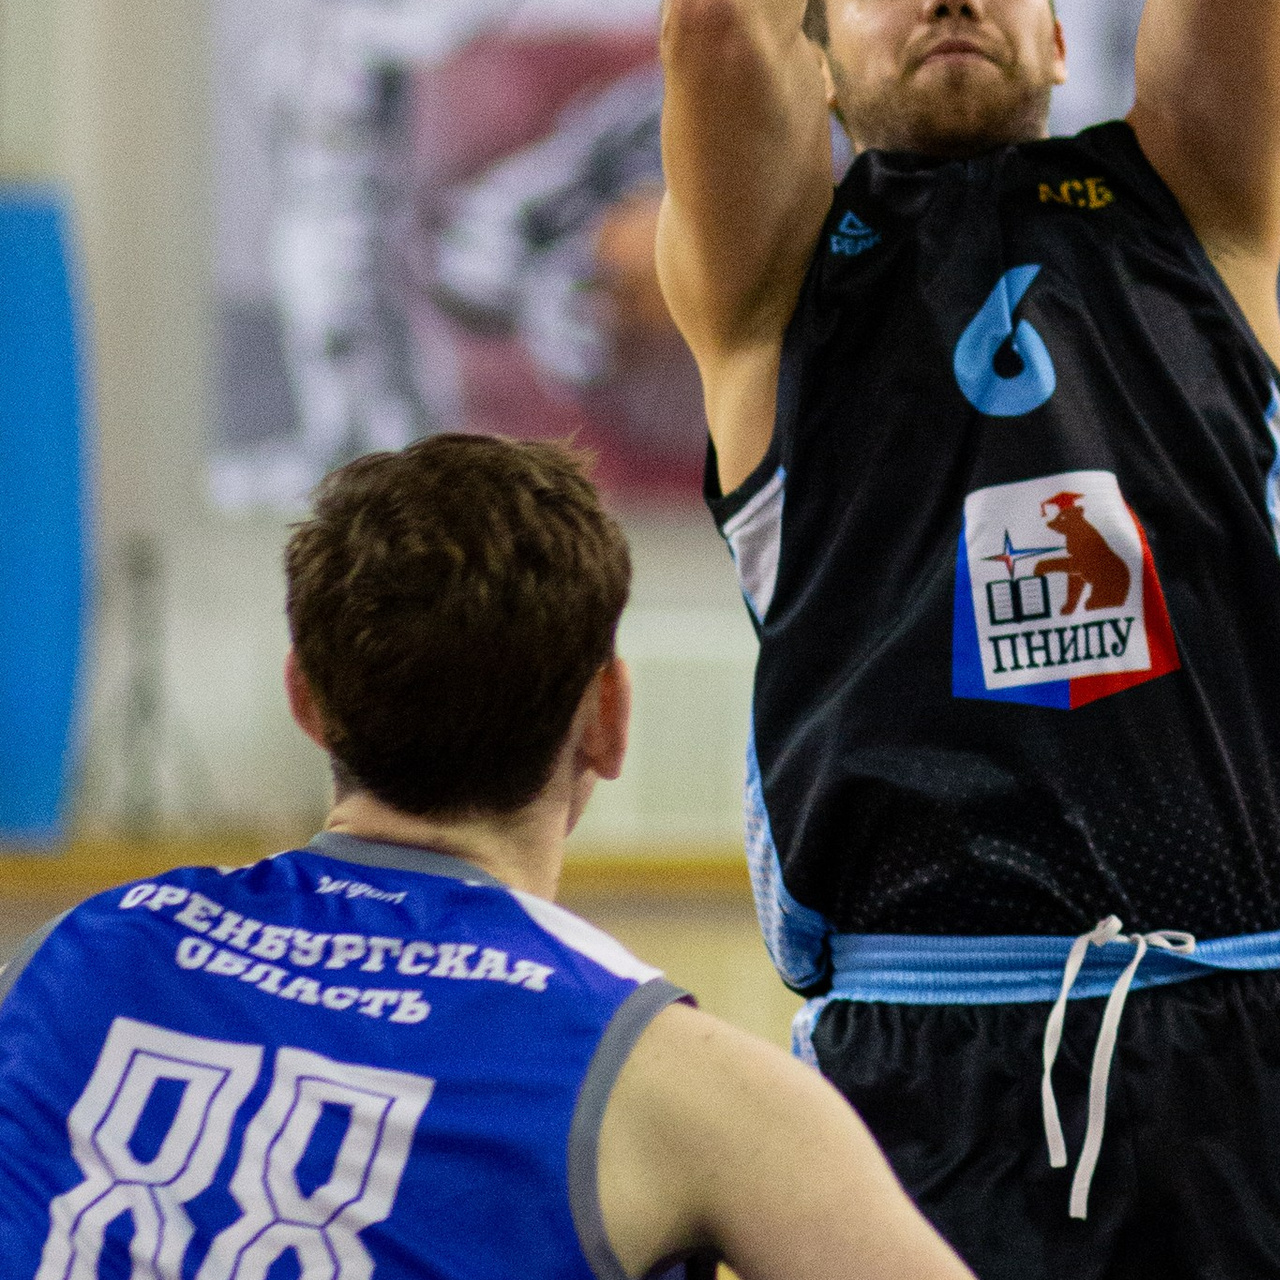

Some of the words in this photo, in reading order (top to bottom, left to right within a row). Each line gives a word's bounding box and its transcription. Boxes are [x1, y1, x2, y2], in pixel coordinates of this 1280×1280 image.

[953, 263, 1057, 418] 6
[987, 617, 1136, 674] ПНИПУ
[118, 881, 556, 993] ОРЕНБУРГСКАЯ
[175, 935, 432, 1025] ОБЛАСТЬ
